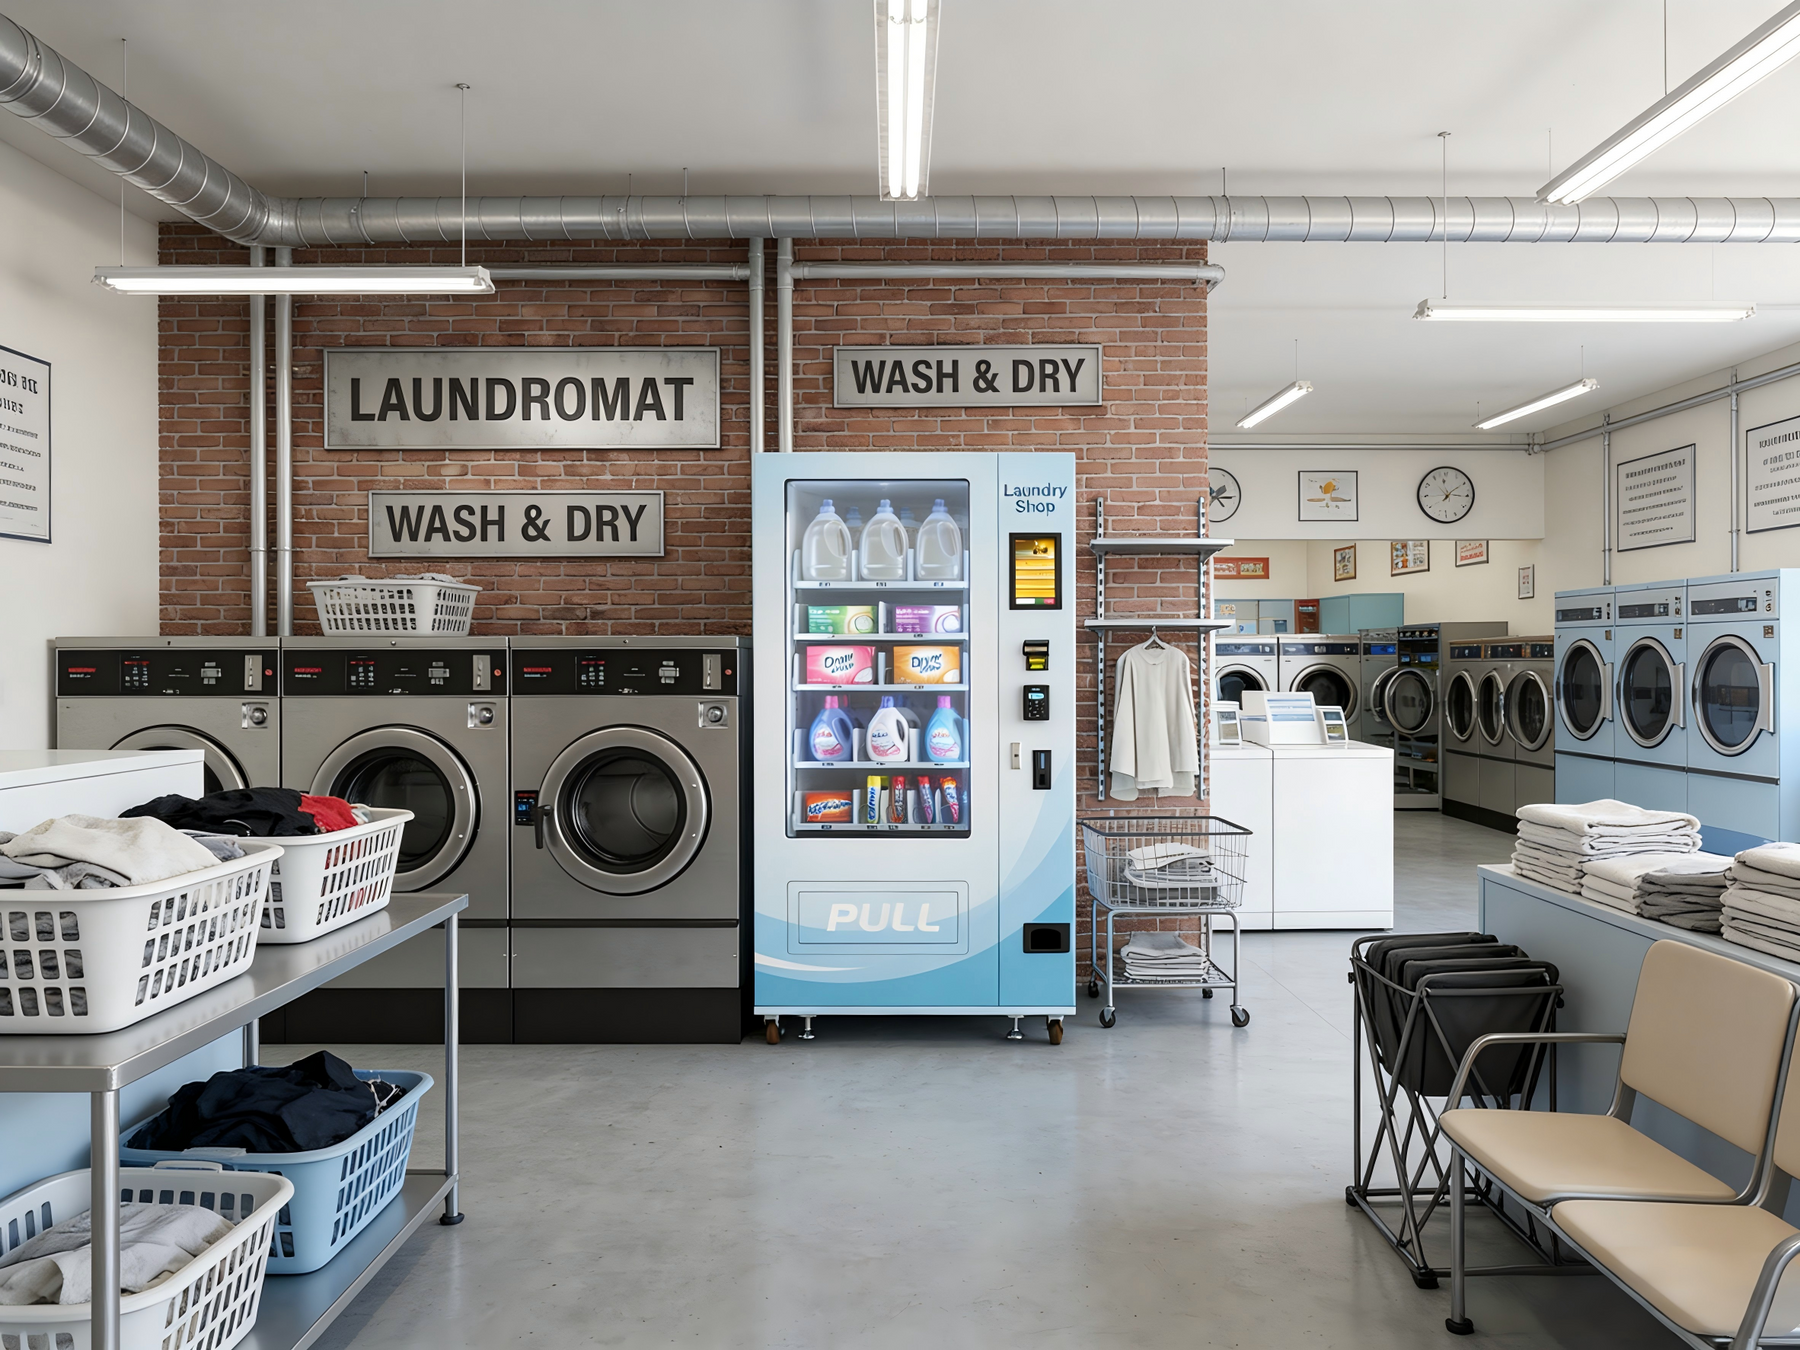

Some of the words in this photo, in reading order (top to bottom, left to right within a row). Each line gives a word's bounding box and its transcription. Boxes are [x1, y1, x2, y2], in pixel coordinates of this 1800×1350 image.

[851, 359, 960, 394] WASH
[972, 359, 1000, 393] &
[1012, 358, 1086, 393] DRY
[350, 377, 694, 422] LAUNDROMAT
[1003, 482, 1068, 499] Laundry
[385, 504, 505, 543] WASH
[521, 504, 551, 543] &
[566, 503, 647, 542] DRY
[1015, 499, 1056, 517] Shop
[826, 902, 940, 932] PULL
